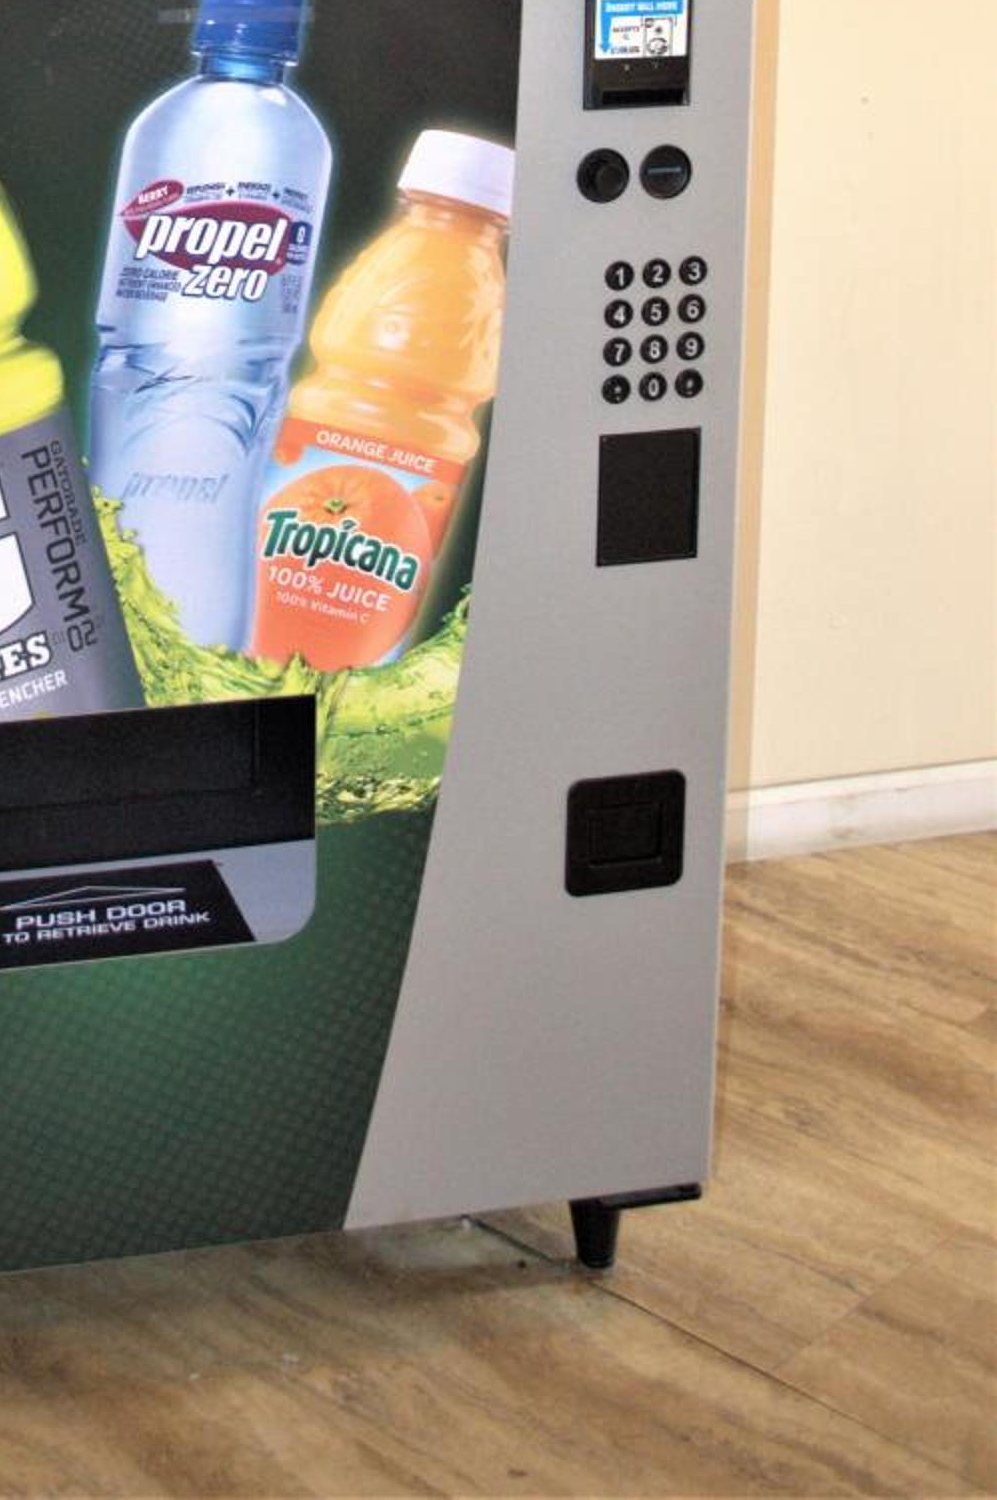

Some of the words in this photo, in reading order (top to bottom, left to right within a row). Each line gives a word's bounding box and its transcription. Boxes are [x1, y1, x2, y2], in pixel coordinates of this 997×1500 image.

[134, 216, 288, 265] propel
[182, 264, 268, 301] zero
[616, 268, 625, 287] 1
[652, 265, 664, 283] 2
[688, 262, 701, 281] 3
[613, 305, 625, 324] 4
[650, 303, 662, 322] 5
[687, 301, 700, 320] 6
[614, 343, 625, 363] 7
[649, 341, 661, 359] 8
[685, 338, 698, 357] 9
[648, 378, 660, 397] 0
[315, 430, 393, 459] ORANGE
[390, 449, 437, 474] JUICE
[49, 440, 86, 545] GATORADE
[22, 445, 96, 622] PERFORM
[262, 509, 419, 592] Tropicana
[267, 565, 322, 594] 100%
[326, 581, 392, 613] JUICE
[309, 599, 358, 619] Vitamin
[358, 611, 370, 623] C
[14, 909, 97, 931] PUSH
[105, 899, 186, 921] DOOR
[3, 932, 29, 944] TO
[36, 919, 136, 942] RETRIEVE
[142, 910, 210, 930] DRINK
